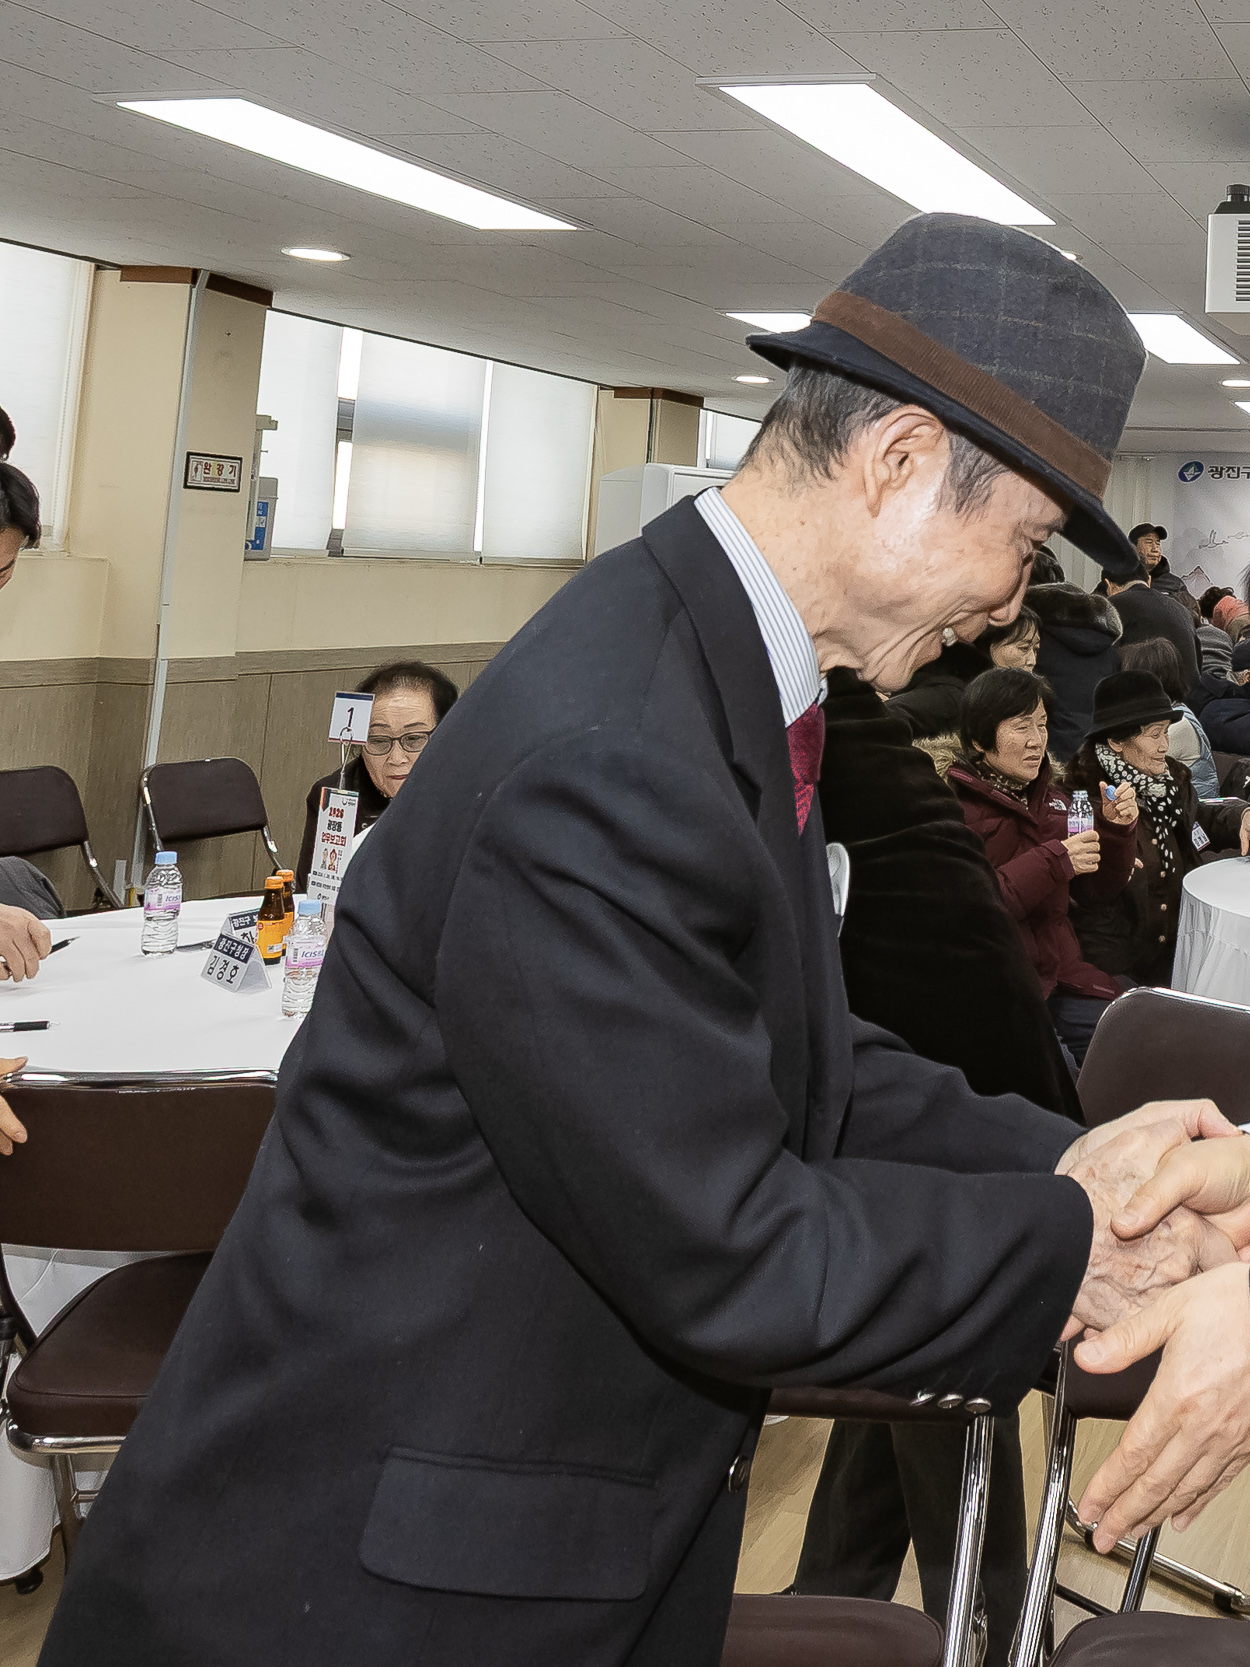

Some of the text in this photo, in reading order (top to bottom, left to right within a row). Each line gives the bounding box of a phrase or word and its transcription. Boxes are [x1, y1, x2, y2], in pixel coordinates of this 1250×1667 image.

[347, 706, 354, 732] 1
[217, 937, 250, 961] 광진구청장
[206, 955, 240, 984] 김경호
